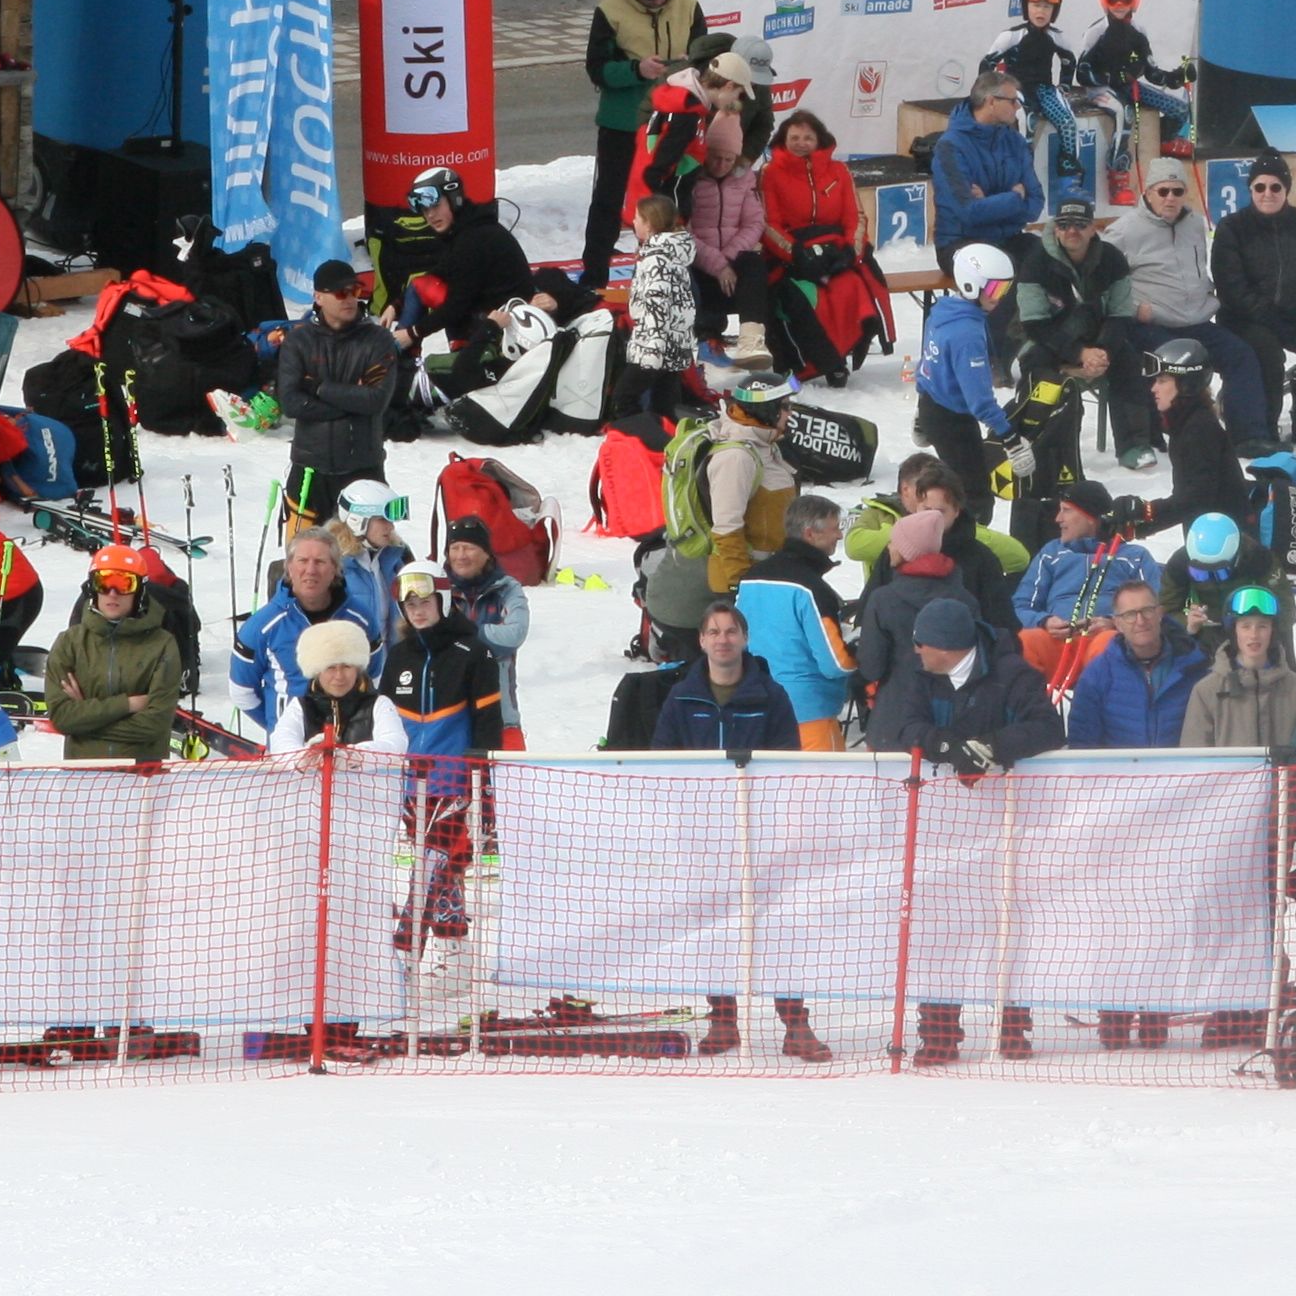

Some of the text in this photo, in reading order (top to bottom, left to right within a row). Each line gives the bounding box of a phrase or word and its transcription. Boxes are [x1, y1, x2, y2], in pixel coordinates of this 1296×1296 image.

[844, 3, 859, 13] Ski
[403, 26, 446, 99] Ski
[365, 146, 489, 166] www.skiamade.com
[1220, 185, 1236, 217] 3
[891, 211, 906, 239] 2
